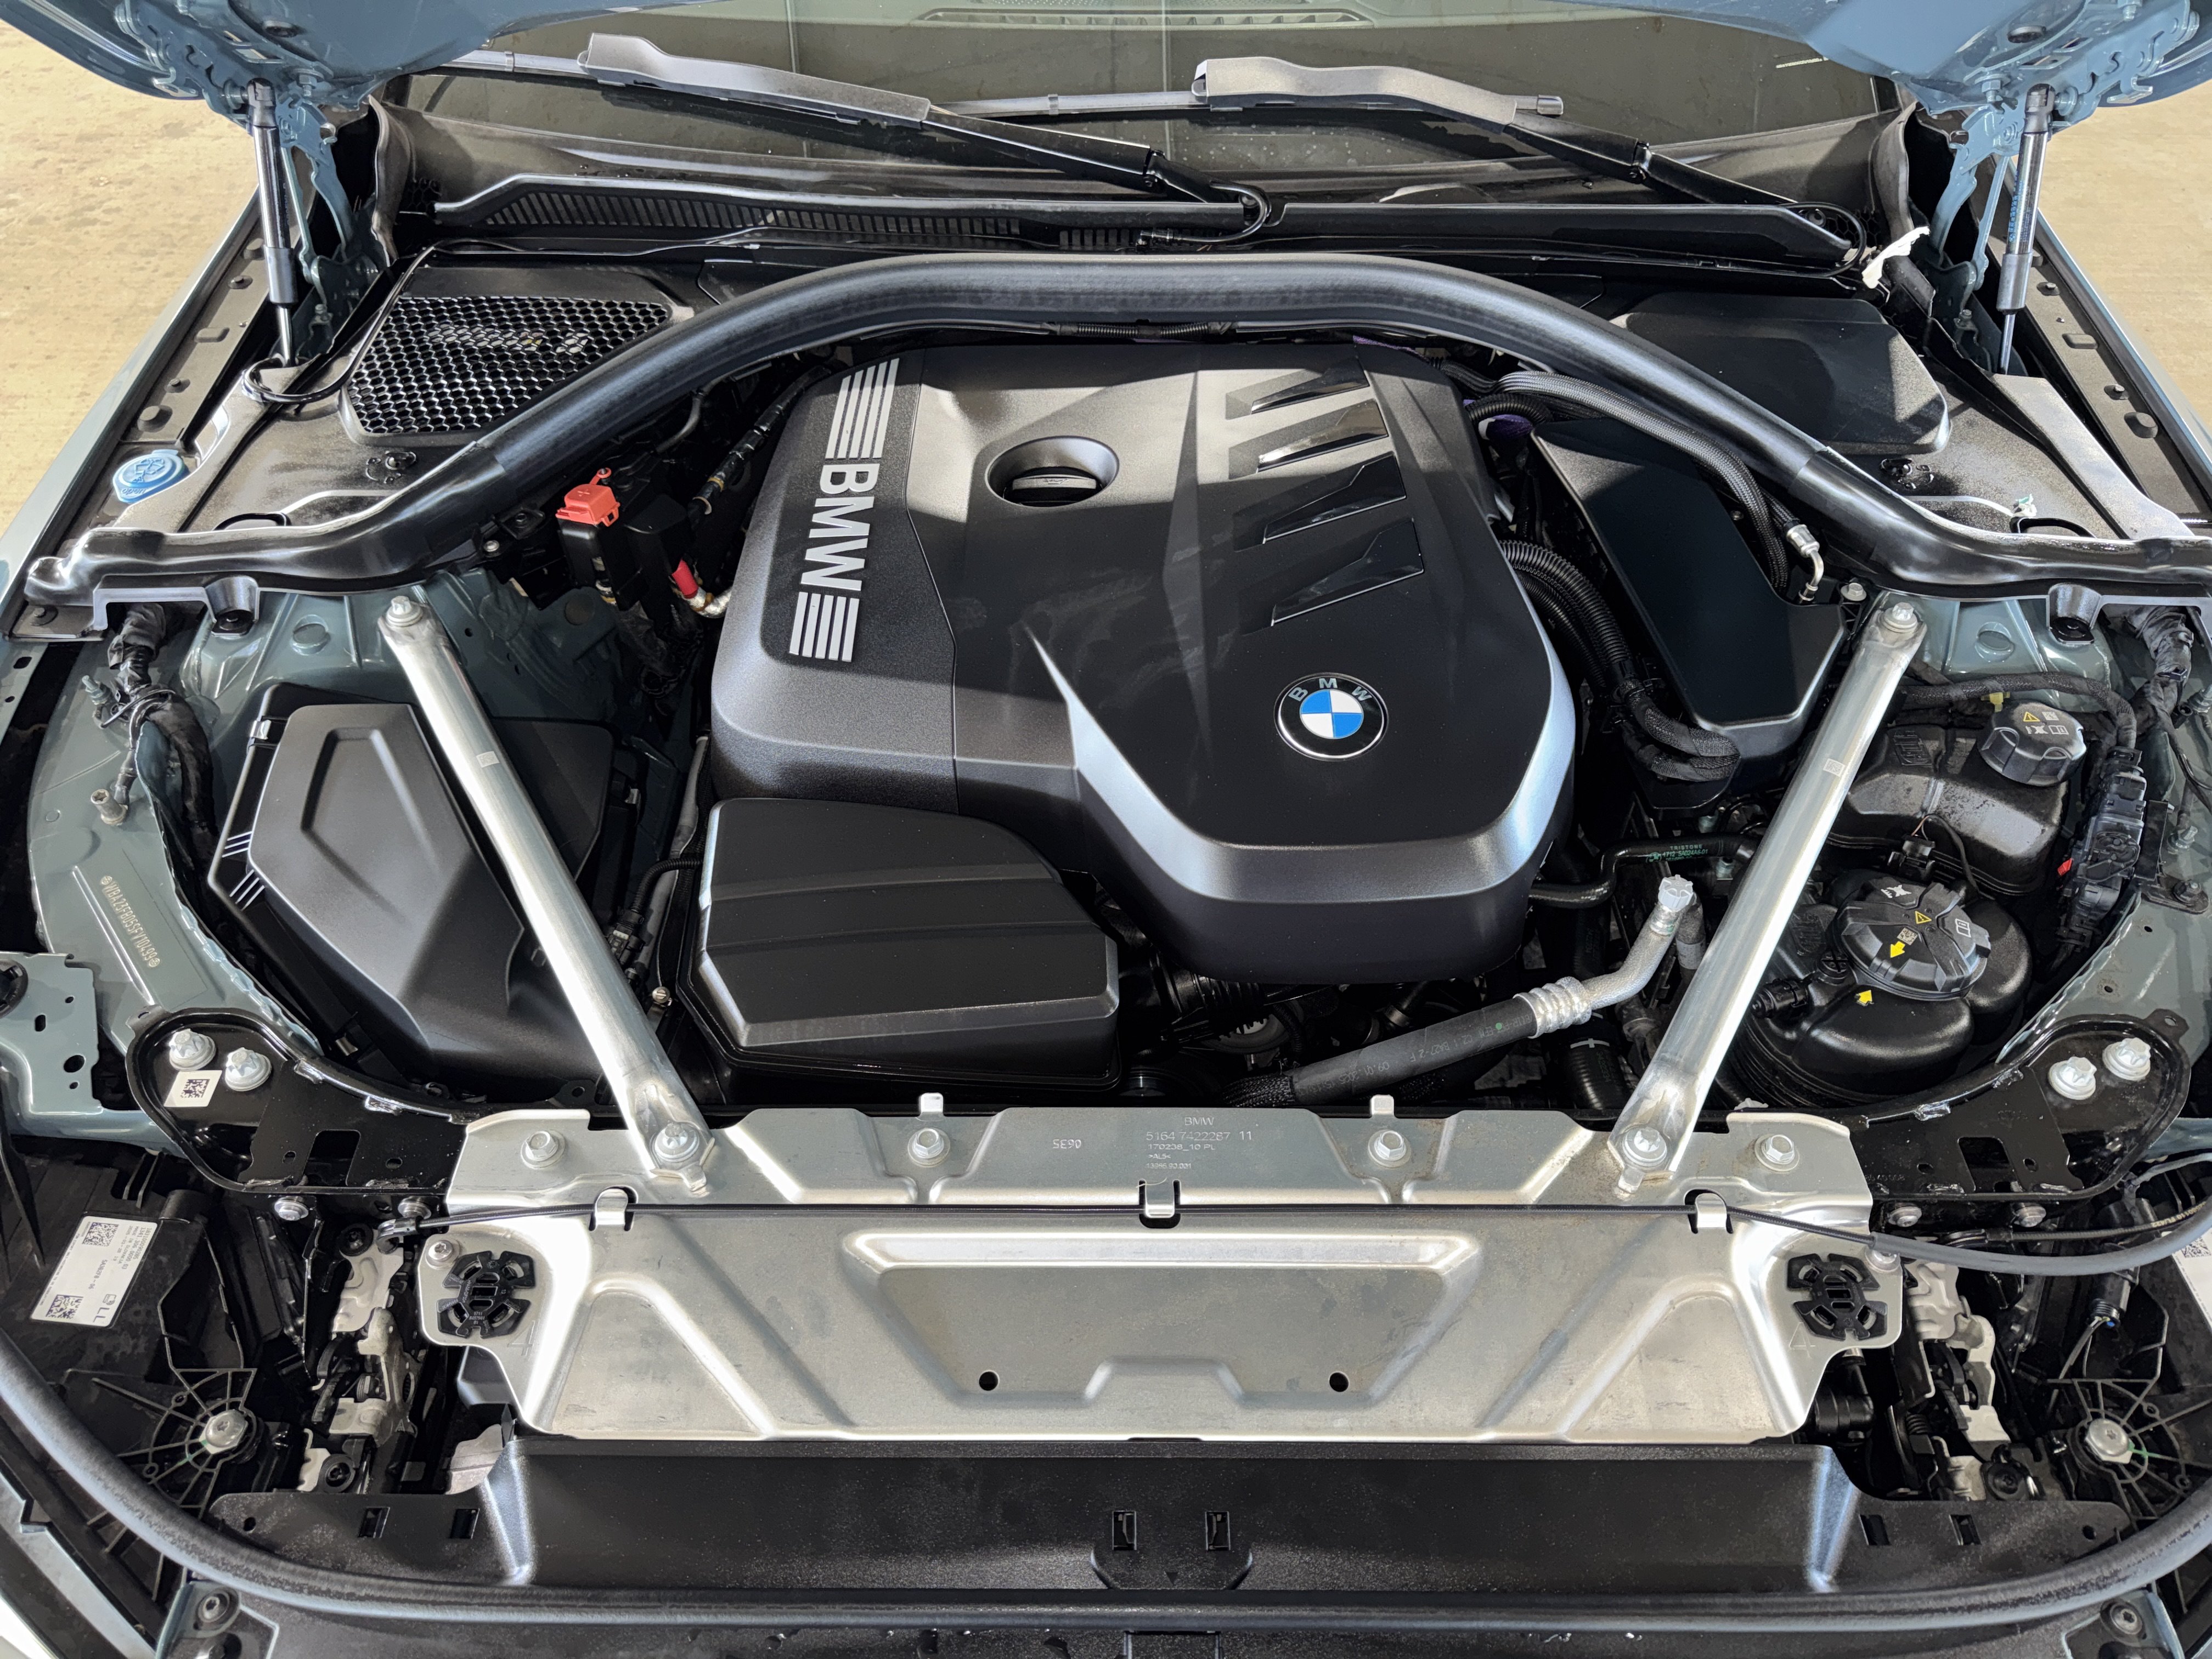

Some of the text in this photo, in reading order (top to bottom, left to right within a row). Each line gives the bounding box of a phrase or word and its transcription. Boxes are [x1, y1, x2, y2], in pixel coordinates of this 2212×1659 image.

[800, 464, 880, 591] BMW
[1288, 678, 1372, 702] BMW
[1184, 1117, 1214, 1125] BMW
[1146, 1131, 1251, 1141] 5164 7422287 11
[92, 1306, 110, 1324] LL
